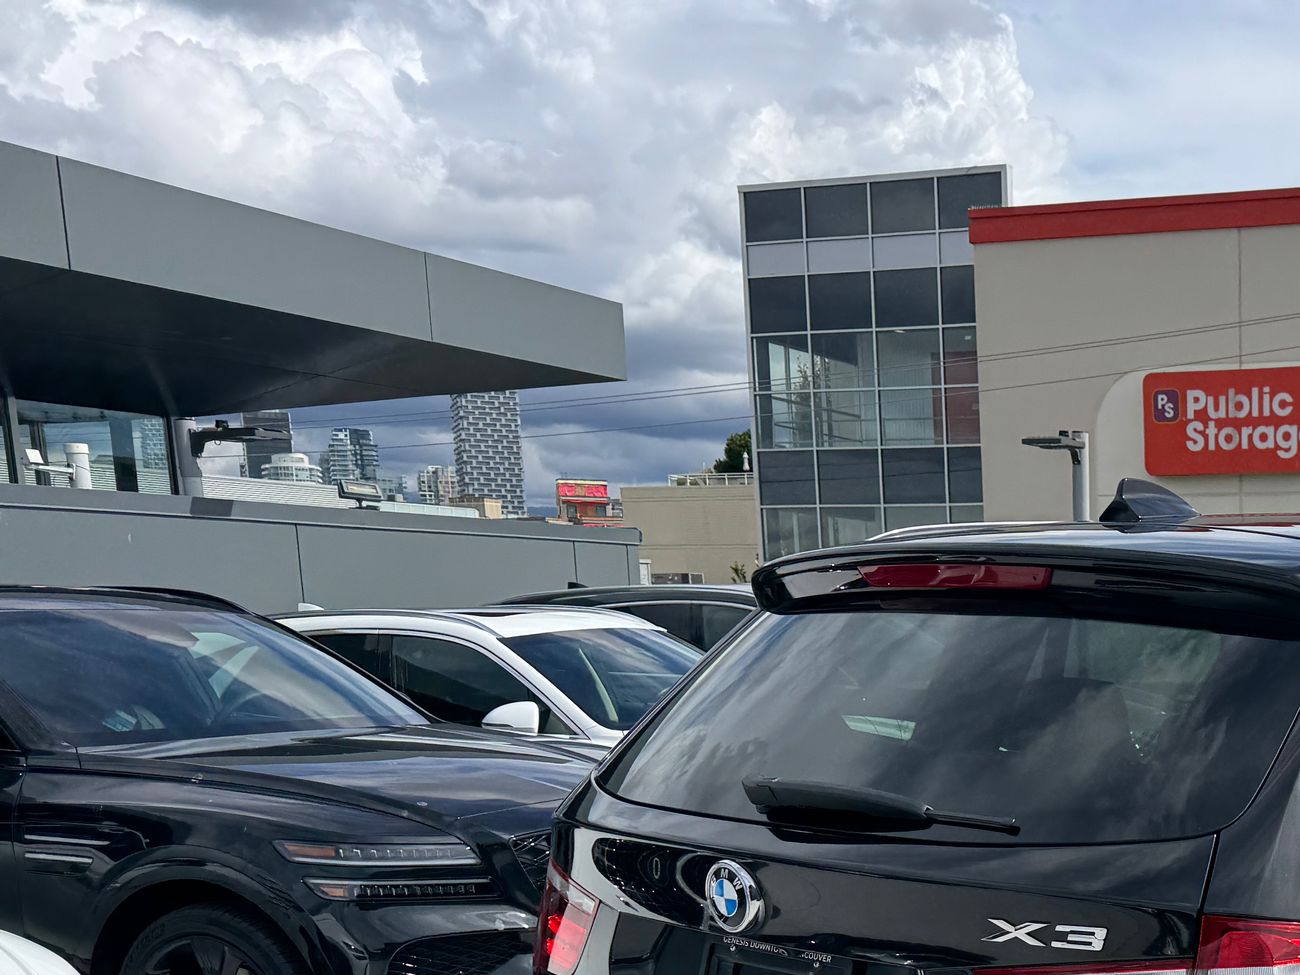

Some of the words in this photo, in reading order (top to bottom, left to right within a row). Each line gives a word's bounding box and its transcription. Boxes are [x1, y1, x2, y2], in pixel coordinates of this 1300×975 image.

[1186, 387, 1293, 419] Public
[981, 918, 1107, 951] X3
[799, 951, 832, 965] COUVER
